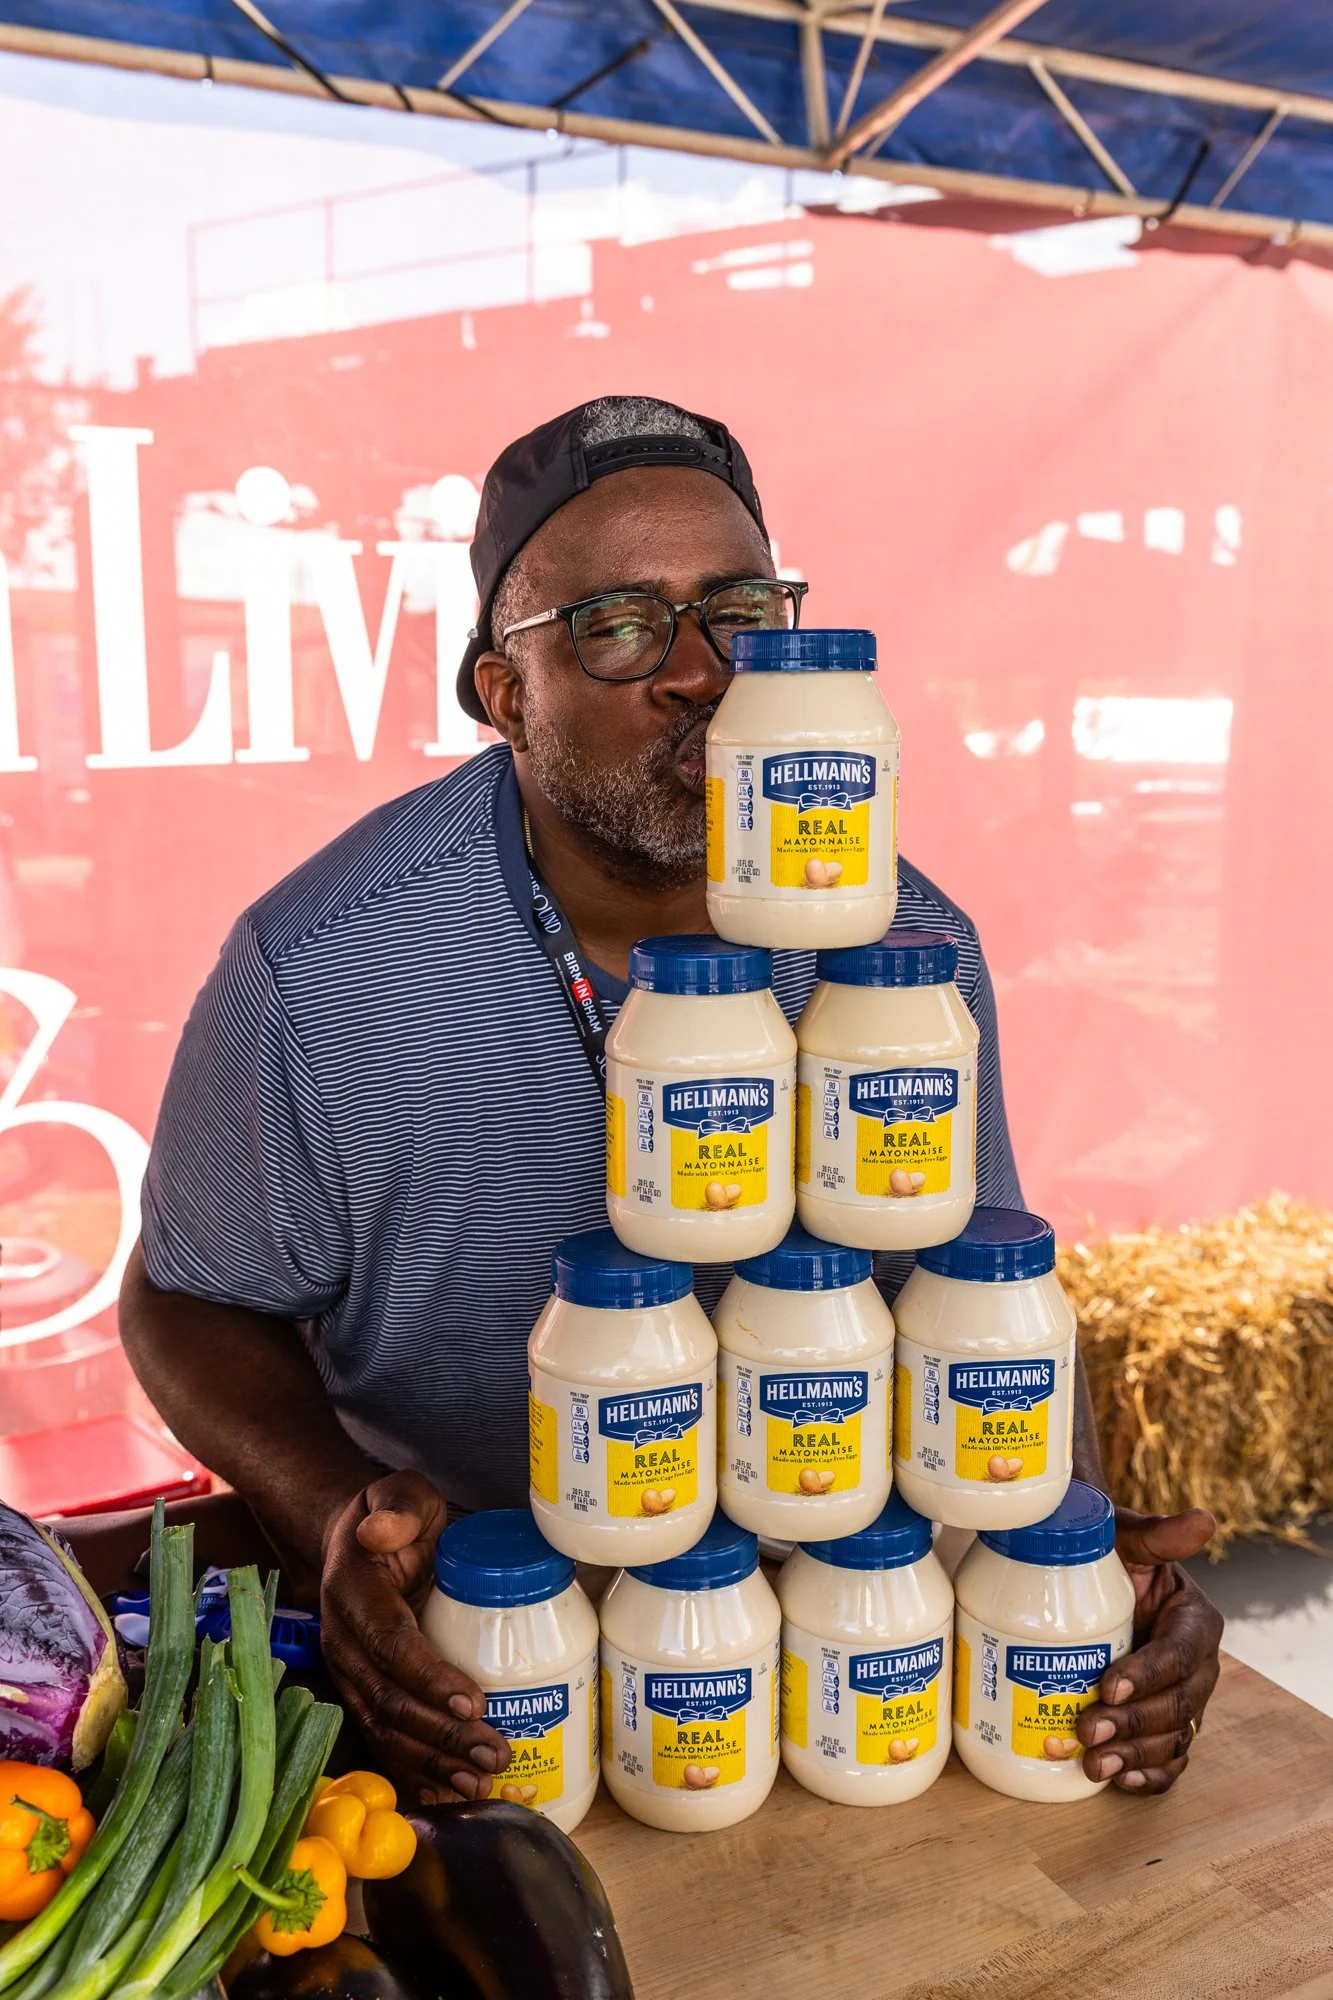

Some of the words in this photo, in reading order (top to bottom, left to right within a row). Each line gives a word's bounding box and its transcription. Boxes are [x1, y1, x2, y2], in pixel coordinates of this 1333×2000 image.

[770, 759, 871, 786] HELLMANN'S
[798, 820, 847, 835] REAL
[783, 836, 860, 845] MAYONNAISE
[563, 951, 603, 1033] BIRMINGHAM
[857, 1073, 953, 1099] HELLMANN'S
[642, 1094, 649, 1102] 90
[670, 1083, 769, 1112] HELLMANN'S
[884, 1132, 931, 1147] REAL
[699, 1143, 747, 1159] REAL
[869, 1146, 943, 1156] MAYONNAISE
[684, 1157, 759, 1169] MAYONNAISE
[956, 1364, 1050, 1389] HELLMANN'S
[767, 1376, 863, 1401] HELLMANN'S
[607, 1388, 698, 1424] HELLMANN'S
[643, 1418, 673, 1427] EST.1913
[982, 1420, 1028, 1435] REAL
[793, 1432, 840, 1447] REAL
[968, 1432, 1040, 1444] MAYONNAISE
[635, 1449, 680, 1468] REAL
[780, 1445, 853, 1456] MAYONNAISE
[621, 1460, 690, 1479] MAYONNAISE
[857, 1644, 940, 1679] HELLMANN'S
[1013, 1648, 1106, 1671] HELLMANN'S
[892, 1672, 918, 1682] EST.1913
[652, 1673, 746, 1699] HELLMANN'S
[482, 1690, 563, 1718] LLMANN'S
[883, 1701, 923, 1720] REAL
[1039, 1703, 1080, 1716] REAL
[869, 1709, 932, 1729] MAYONNAISE
[677, 1730, 724, 1744] REAL
[664, 1740, 736, 1753] MAYONNAISE
[511, 1747, 541, 1763] EAL
[505, 1757, 554, 1773] ONNAISE
